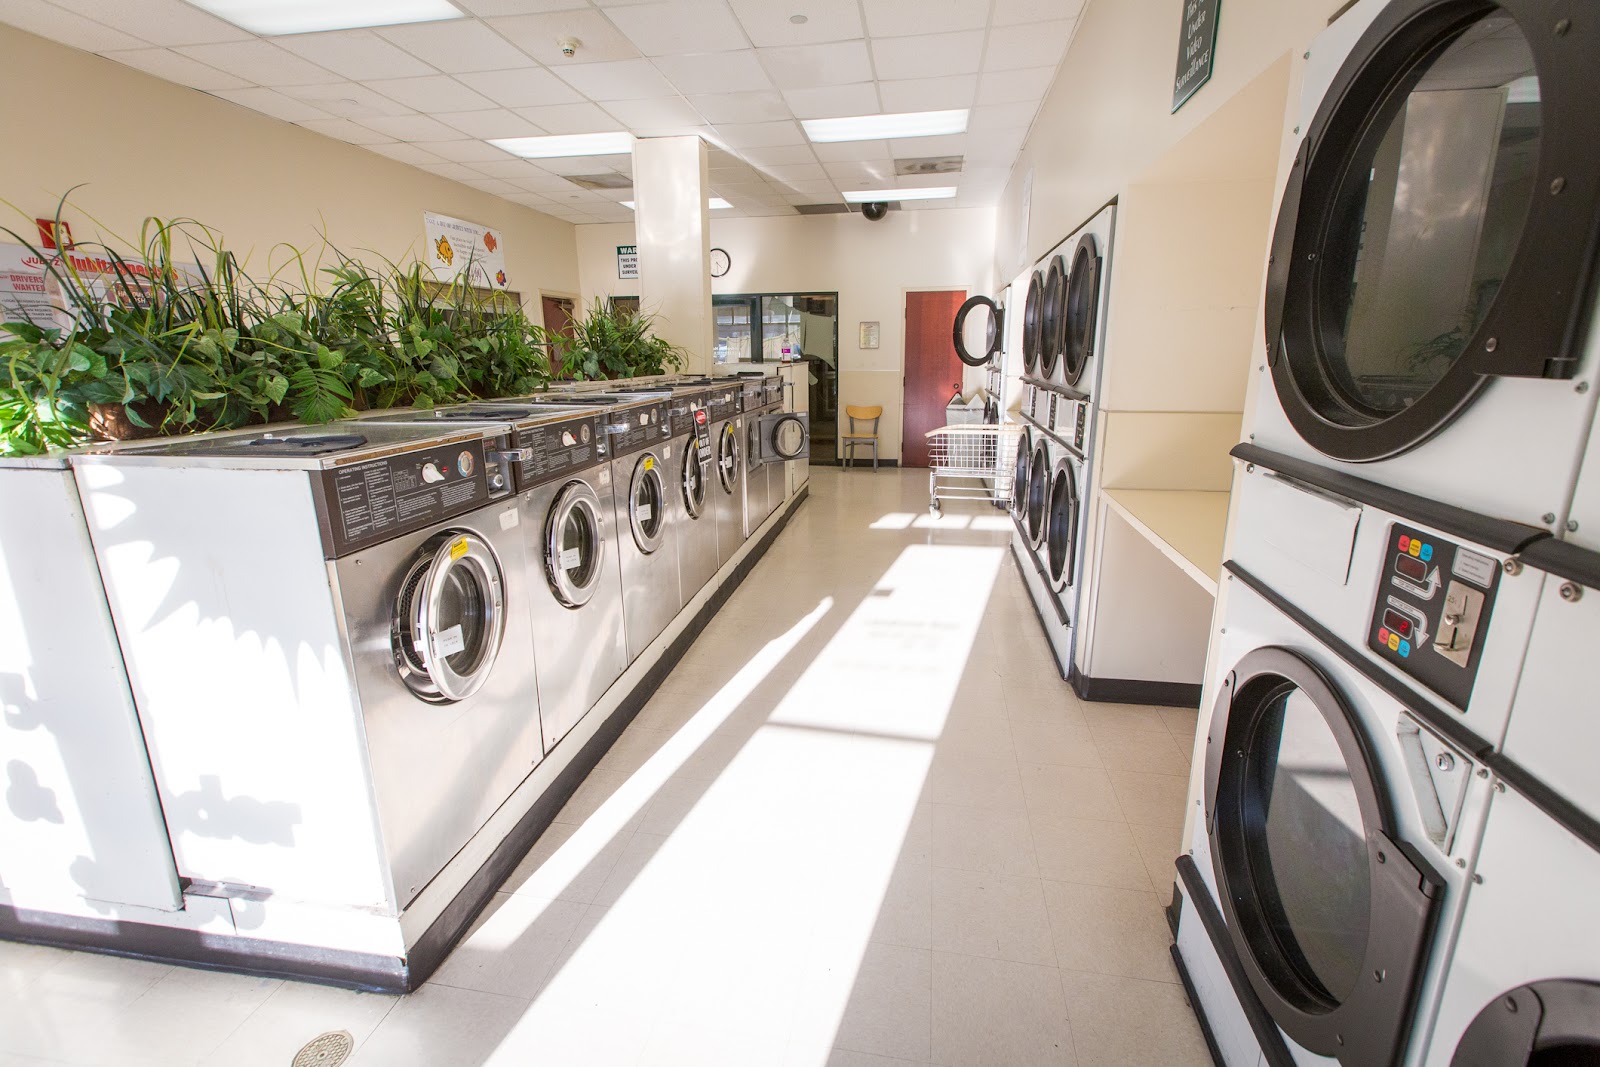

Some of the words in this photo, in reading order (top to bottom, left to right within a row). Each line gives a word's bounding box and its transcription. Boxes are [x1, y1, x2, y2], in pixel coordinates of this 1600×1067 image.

[10, 274, 44, 284] DRIVERS
[13, 283, 46, 292] WANTED
[1399, 620, 1408, 633] 2
